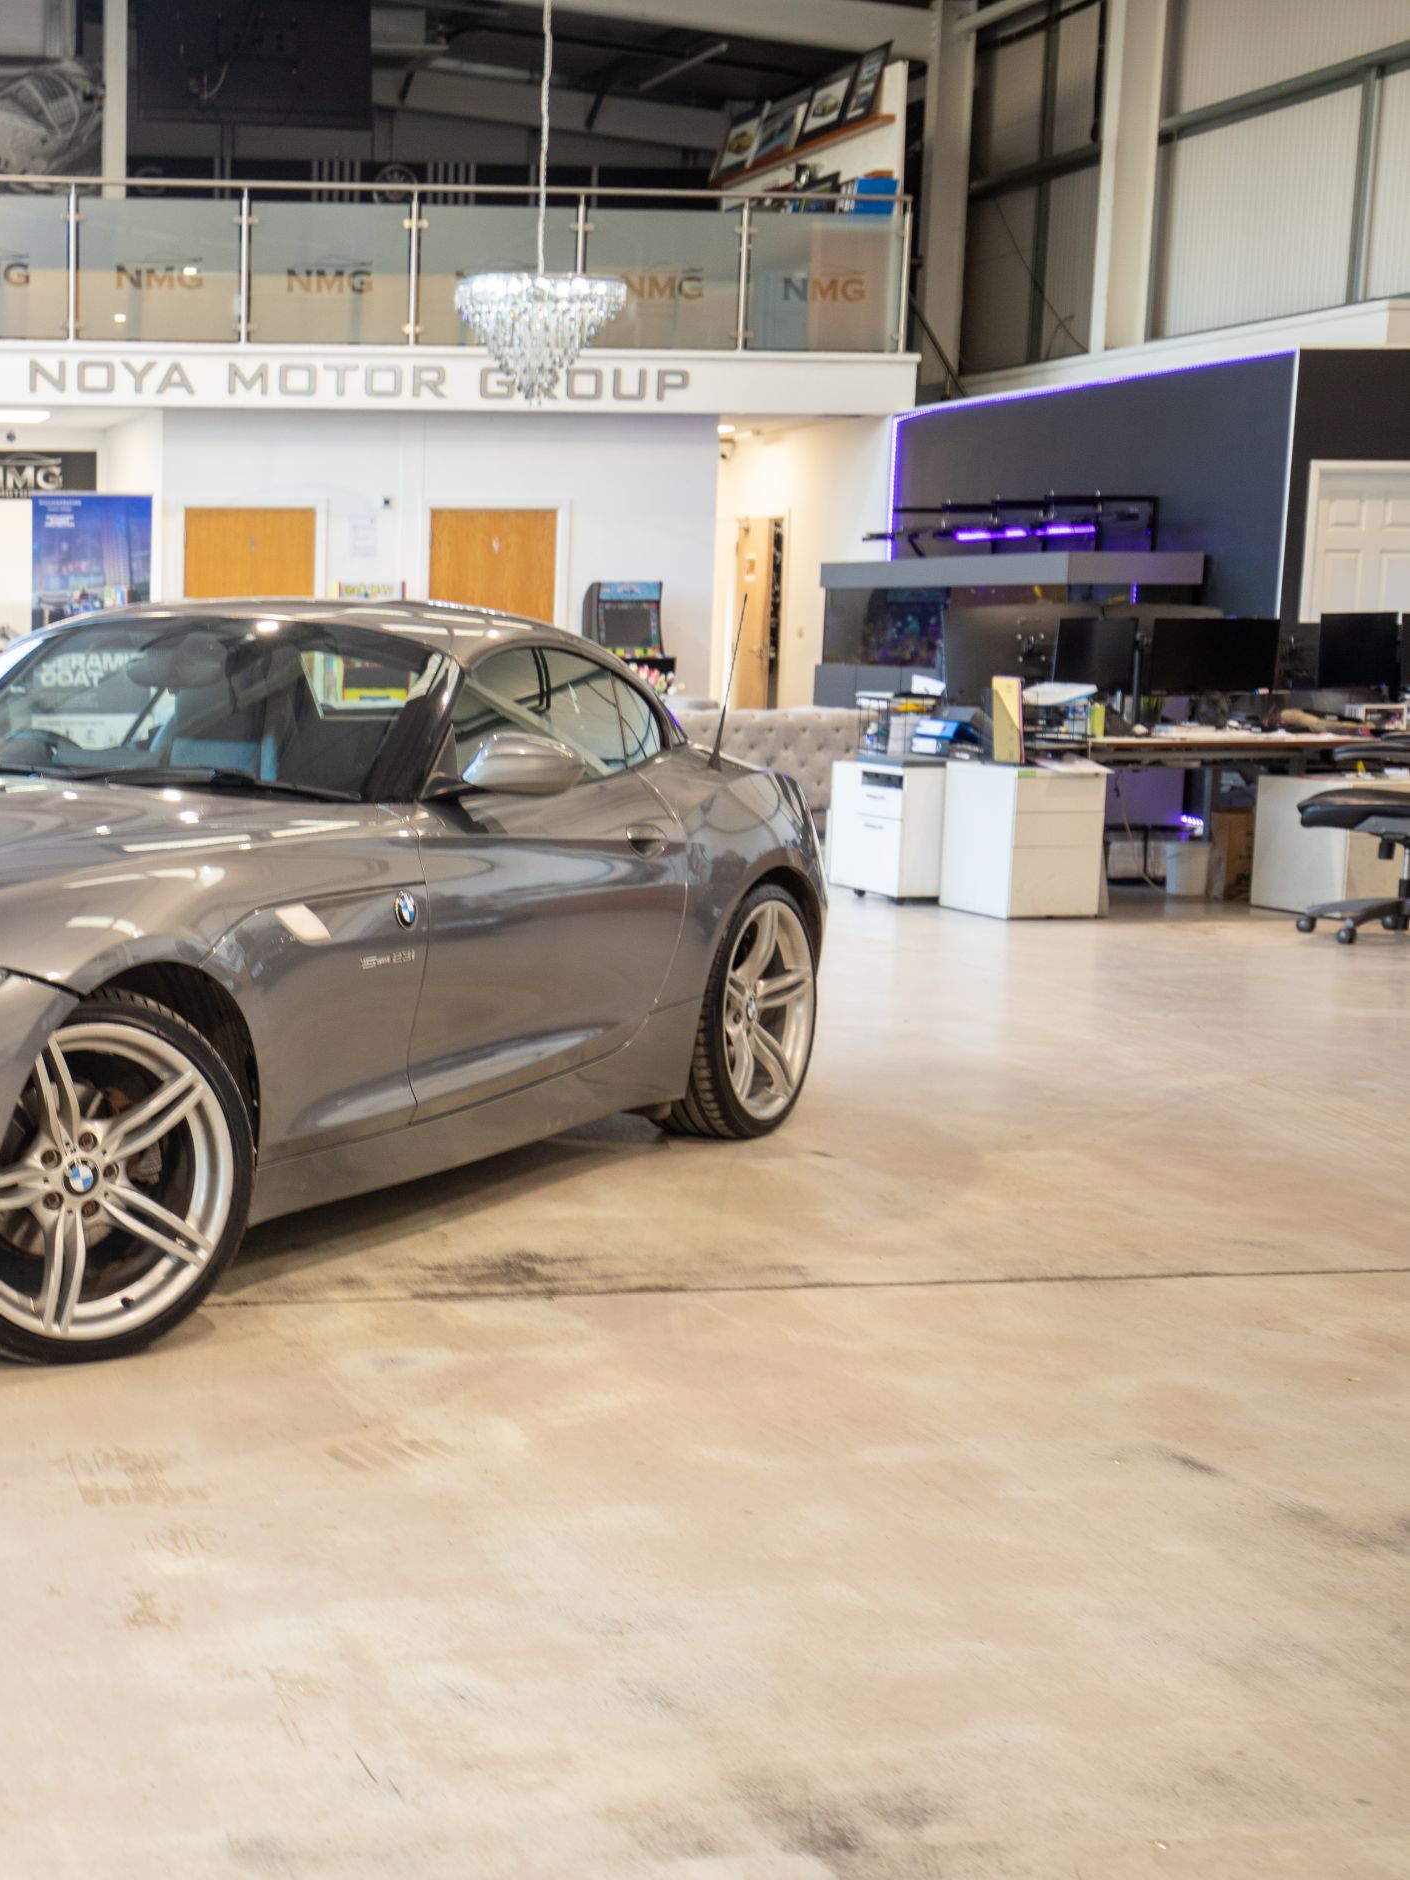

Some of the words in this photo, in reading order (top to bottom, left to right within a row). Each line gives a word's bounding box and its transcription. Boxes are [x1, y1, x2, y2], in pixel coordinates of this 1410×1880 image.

[116, 263, 205, 290] NMG
[286, 268, 374, 295] NMG
[622, 273, 704, 300] NMG
[783, 275, 866, 303] NMG
[29, 360, 195, 395] NOYA
[228, 362, 447, 399] MOTOR
